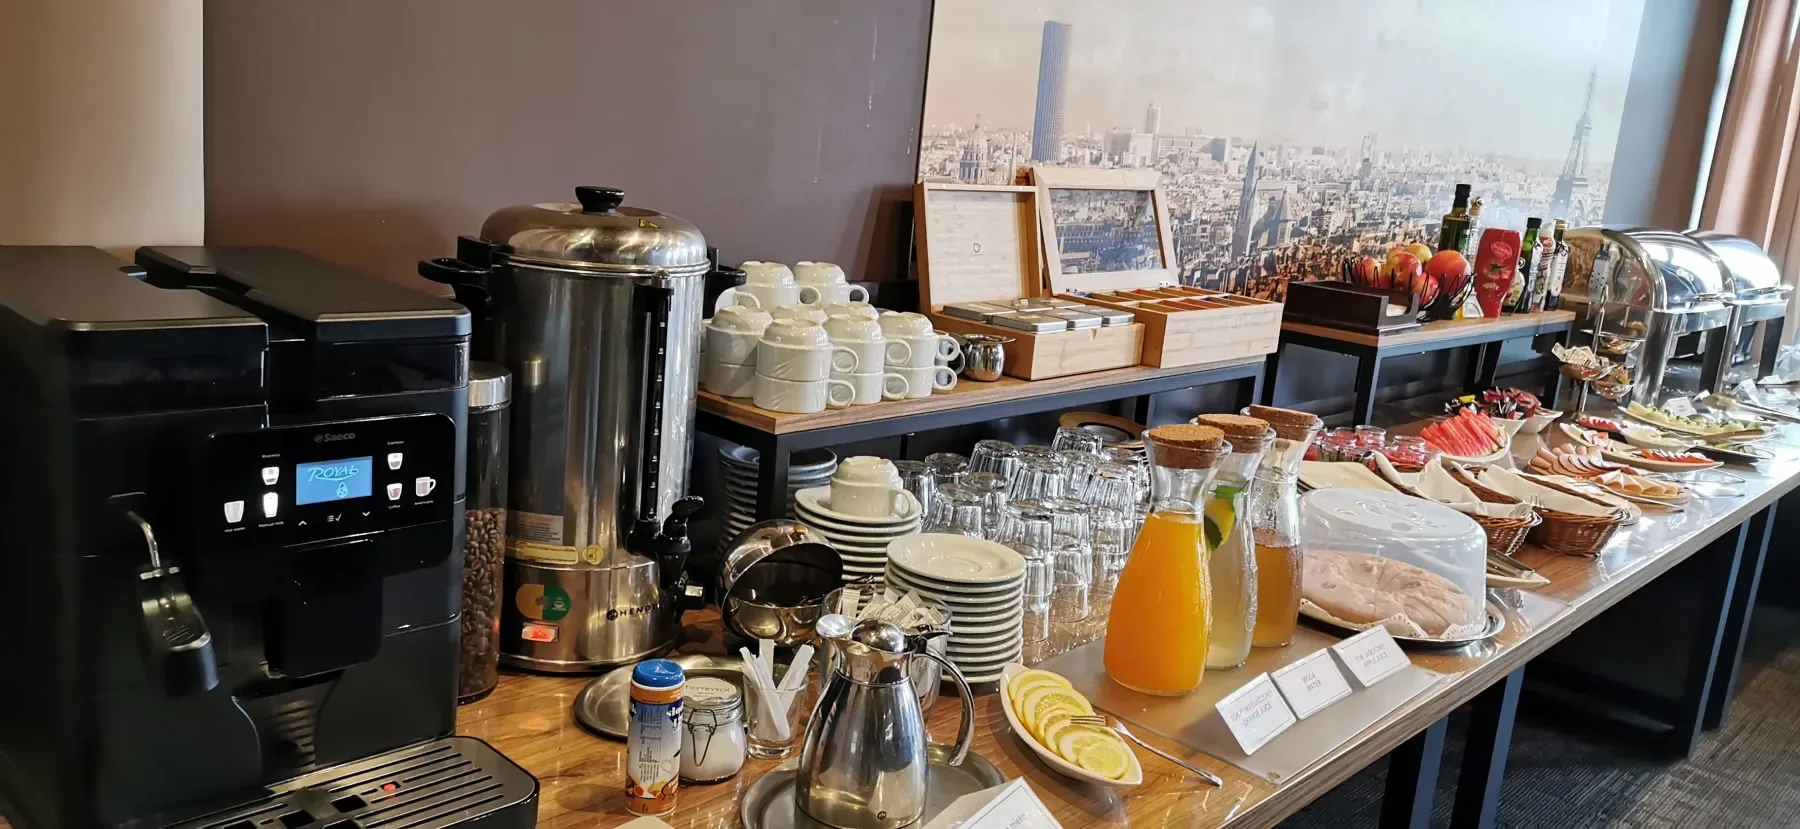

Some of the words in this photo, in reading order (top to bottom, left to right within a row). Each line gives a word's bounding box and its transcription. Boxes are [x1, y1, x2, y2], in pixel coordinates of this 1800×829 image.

[323, 433, 356, 442] Saeco
[307, 464, 360, 482] ROYAL
[1306, 679, 1323, 692] WATER
[1009, 813, 1027, 829] mleko
